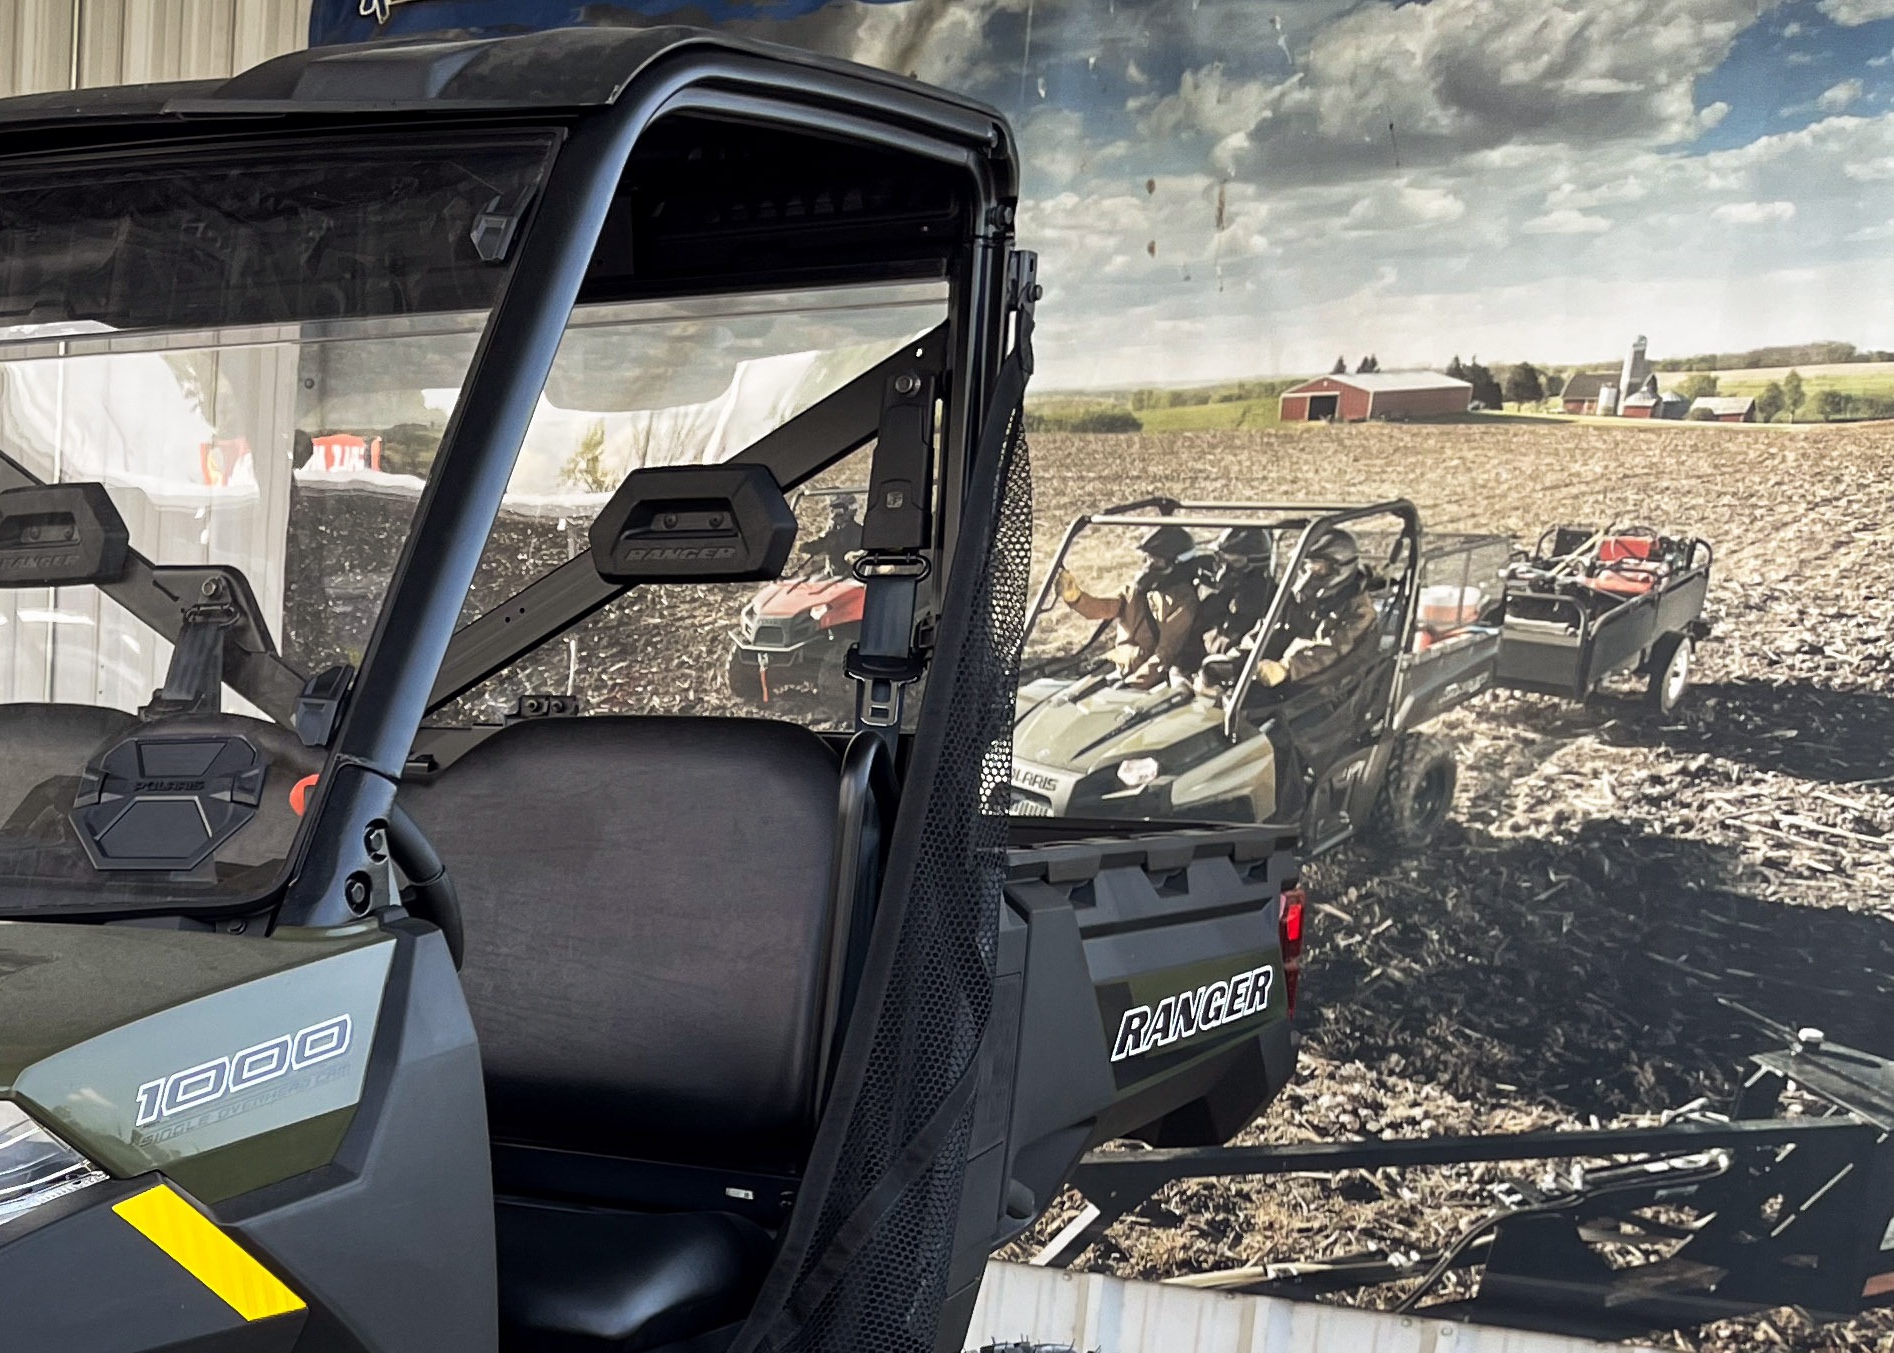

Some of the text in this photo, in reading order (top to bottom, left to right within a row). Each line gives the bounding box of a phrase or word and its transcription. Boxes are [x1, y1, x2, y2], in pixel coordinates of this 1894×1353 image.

[625, 546, 736, 561] RANGER
[1110, 964, 1274, 1062] RANGER
[136, 1013, 352, 1126] 1000
